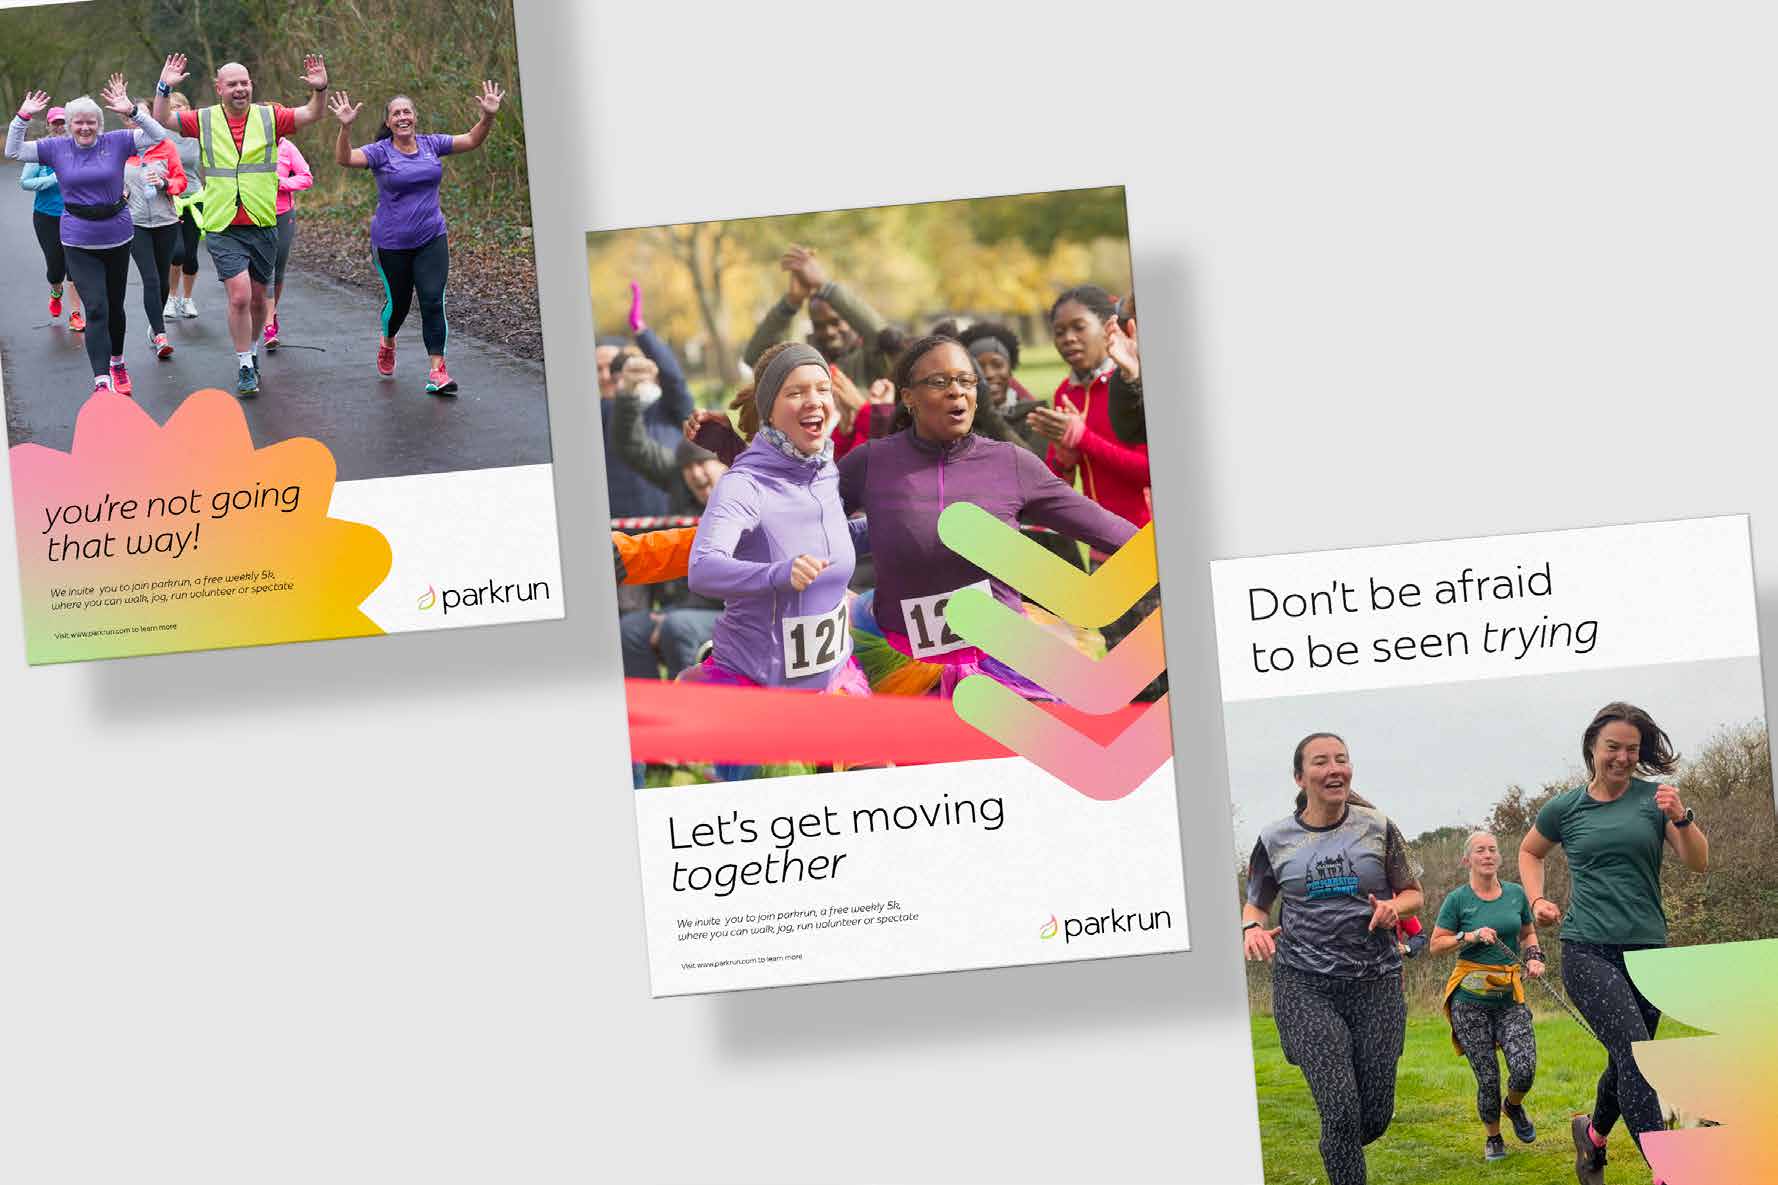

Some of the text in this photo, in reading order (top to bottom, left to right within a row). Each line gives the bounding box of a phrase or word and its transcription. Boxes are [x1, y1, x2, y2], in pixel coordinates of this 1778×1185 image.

[42, 481, 301, 535] you're not going
[48, 522, 201, 562] that way!
[50, 588, 67, 598] We
[68, 585, 95, 596] invite
[99, 584, 117, 596] you
[119, 583, 131, 592] to
[131, 581, 150, 593] join
[203, 575, 223, 587] free
[225, 570, 260, 583] weekly
[51, 601, 82, 611] where
[84, 600, 103, 610] you
[104, 598, 123, 606] can
[170, 591, 188, 600] run
[190, 586, 236, 599] volunteer
[238, 586, 250, 594] or
[251, 581, 295, 594] spectate
[441, 577, 551, 615] parkrun
[1248, 561, 1553, 622] Don't be afraid
[70, 627, 131, 639] www.parkrun.com
[140, 624, 158, 632] learn
[158, 622, 178, 631] more
[790, 604, 848, 670] 127
[1252, 615, 1599, 673] to be seen trying
[669, 793, 1005, 850] Let's get moving
[672, 849, 848, 897] together
[676, 919, 693, 929] We
[694, 916, 721, 927] invite
[724, 916, 744, 927] you
[745, 914, 756, 923] to
[756, 912, 776, 923] join
[828, 905, 849, 918] free
[850, 902, 885, 914] weekly
[677, 932, 709, 942] where
[709, 930, 729, 942] you
[730, 927, 749, 937] can
[796, 922, 814, 931] run
[815, 918, 862, 930] volunteer
[863, 917, 875, 925] or
[876, 912, 920, 925] spectate
[1063, 907, 1172, 945] parkrun
[697, 957, 757, 969] www.parkrun.com
[784, 953, 804, 961] more
